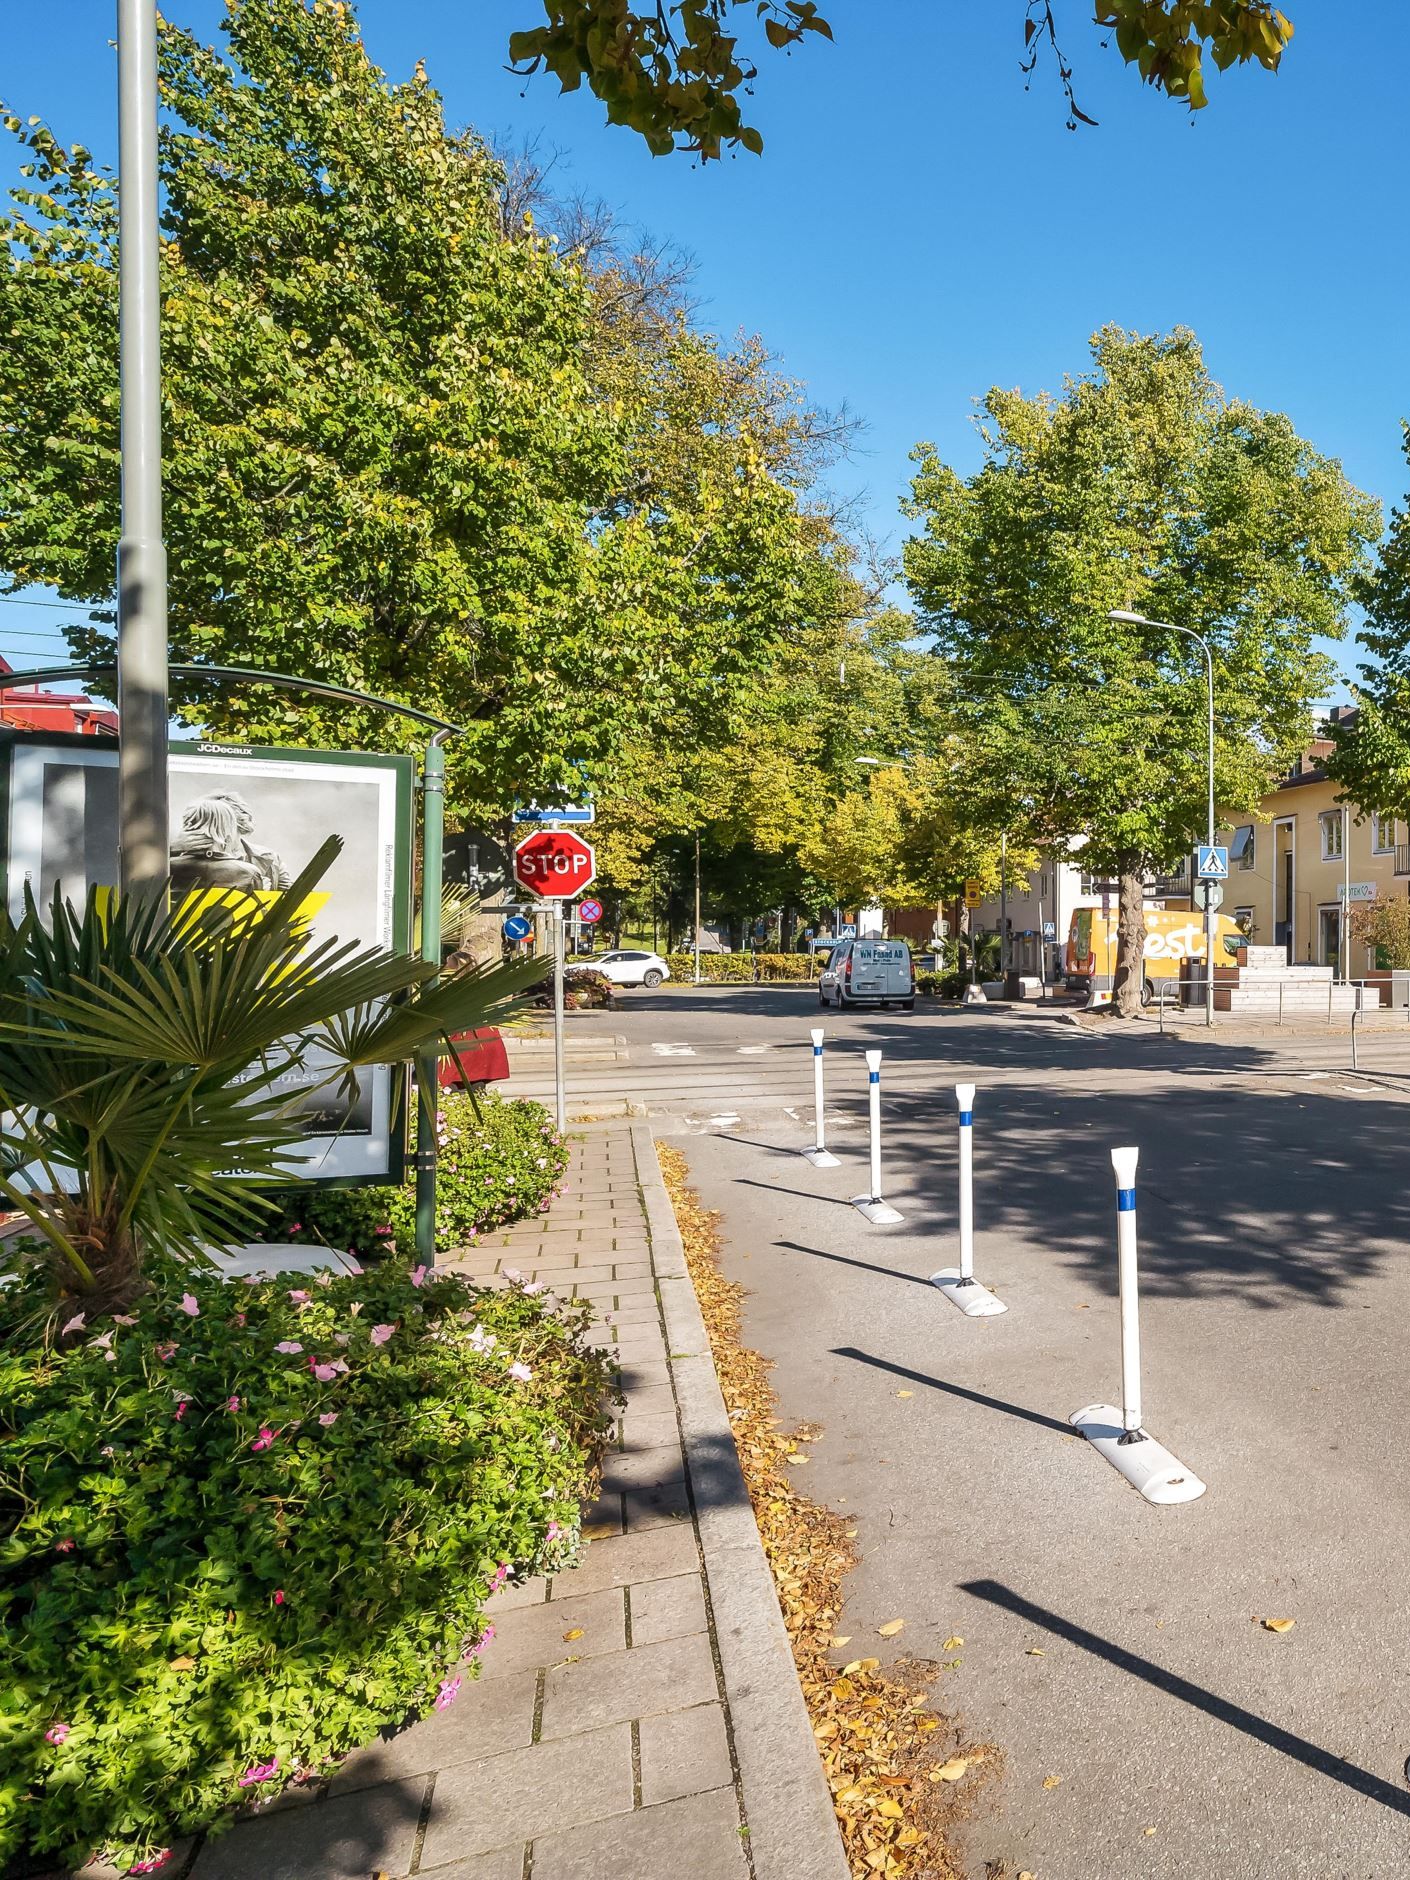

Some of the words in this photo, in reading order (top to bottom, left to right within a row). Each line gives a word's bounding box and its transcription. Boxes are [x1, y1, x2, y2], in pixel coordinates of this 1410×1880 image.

[197, 743, 253, 756] JCDecaux
[521, 854, 588, 875] STOP
[860, 949, 872, 959] WN
[873, 949, 892, 959] Fasad
[894, 949, 903, 959] AB
